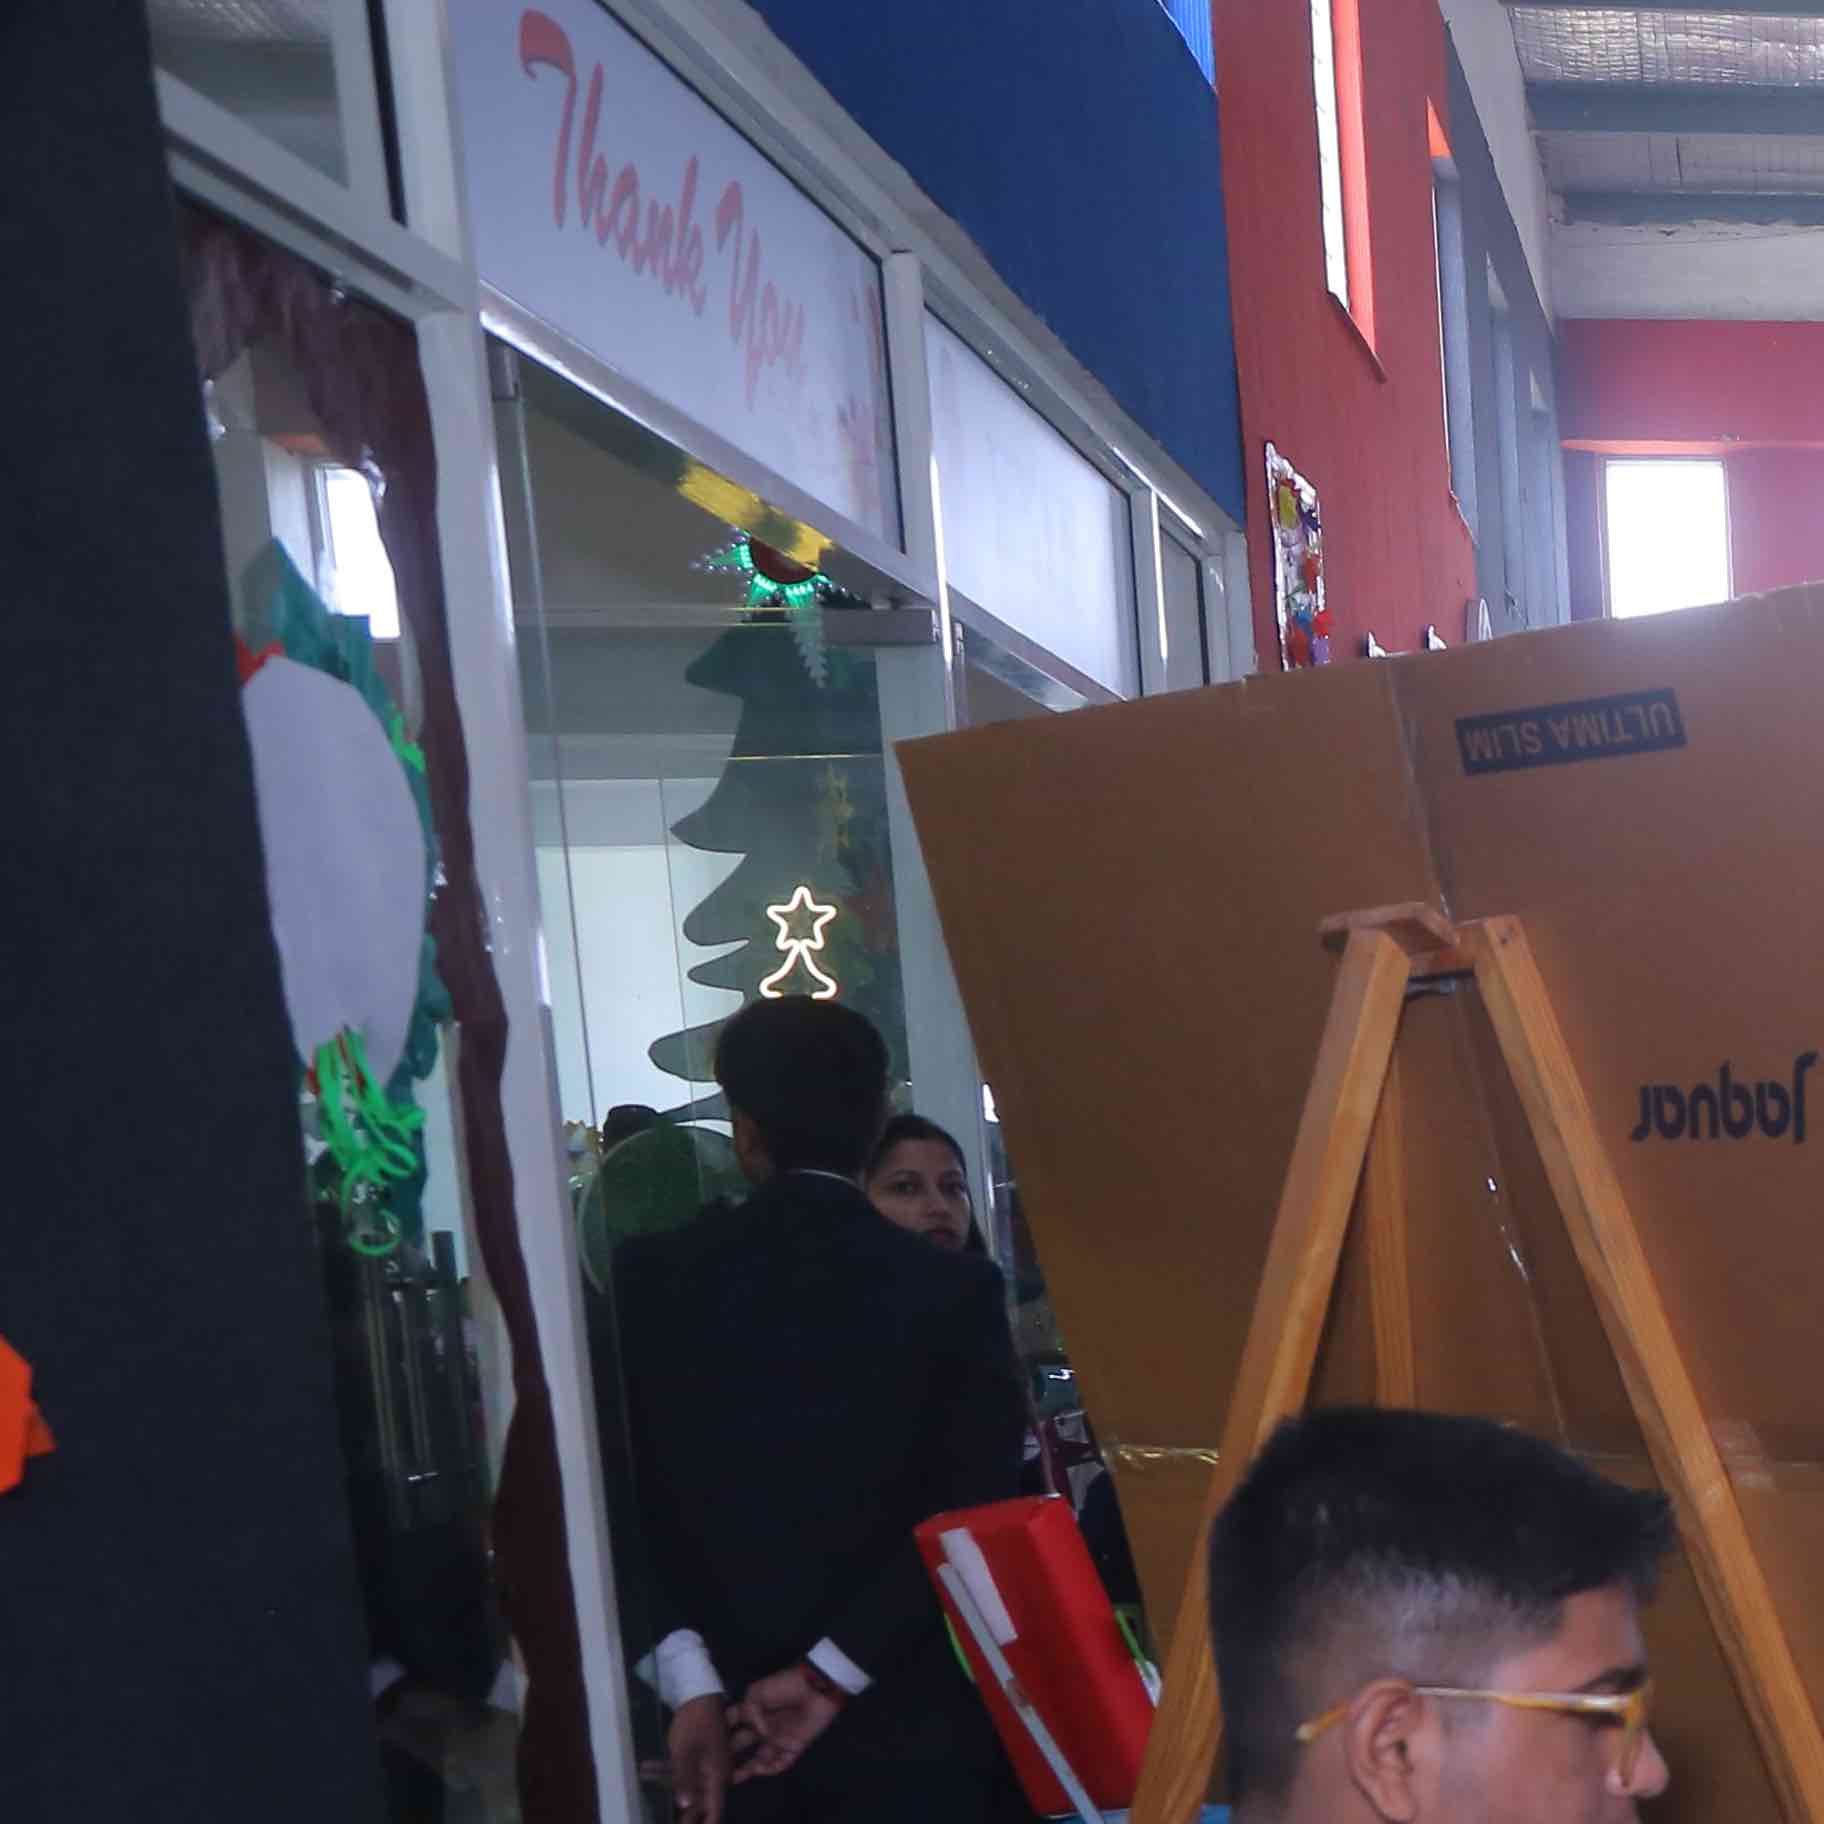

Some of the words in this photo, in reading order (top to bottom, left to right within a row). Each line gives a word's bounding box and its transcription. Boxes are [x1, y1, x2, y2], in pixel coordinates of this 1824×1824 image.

[518, 8, 707, 318] Thank
[714, 179, 807, 412] You
[1465, 720, 1544, 762] SLIM
[1549, 702, 1679, 750] ULTIMA
